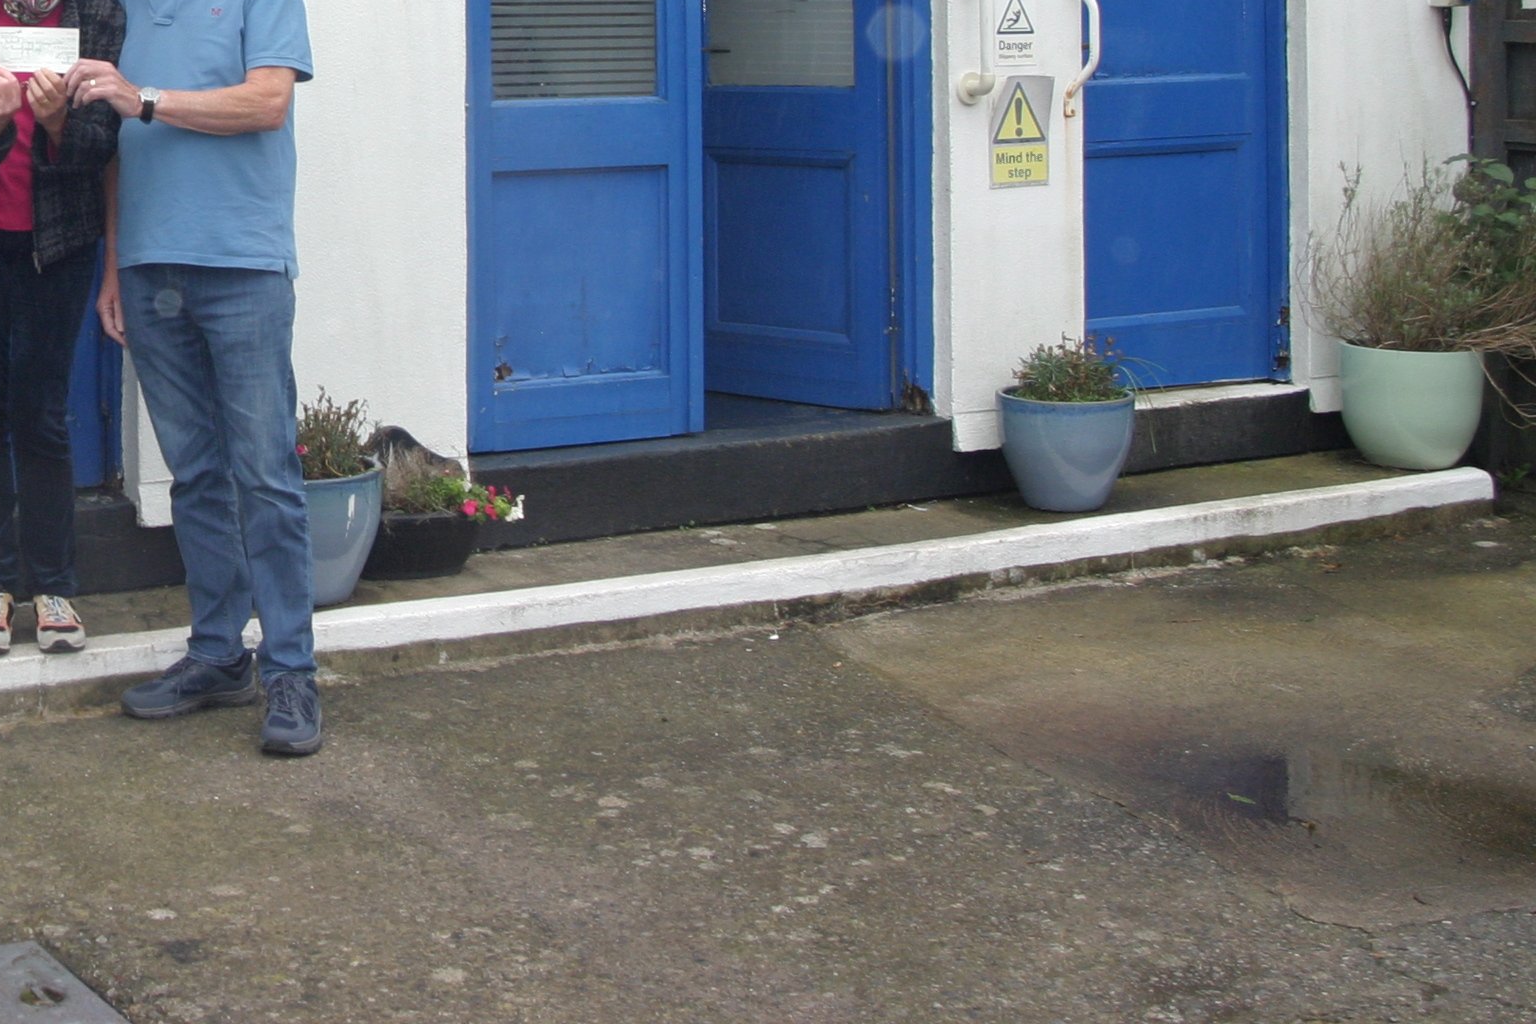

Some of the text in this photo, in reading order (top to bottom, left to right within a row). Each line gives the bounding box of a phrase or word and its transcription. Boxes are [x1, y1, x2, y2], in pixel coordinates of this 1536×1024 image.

[998, 40, 1033, 53] Danger
[996, 151, 1043, 164] Mind the
[1007, 167, 1032, 180] step
